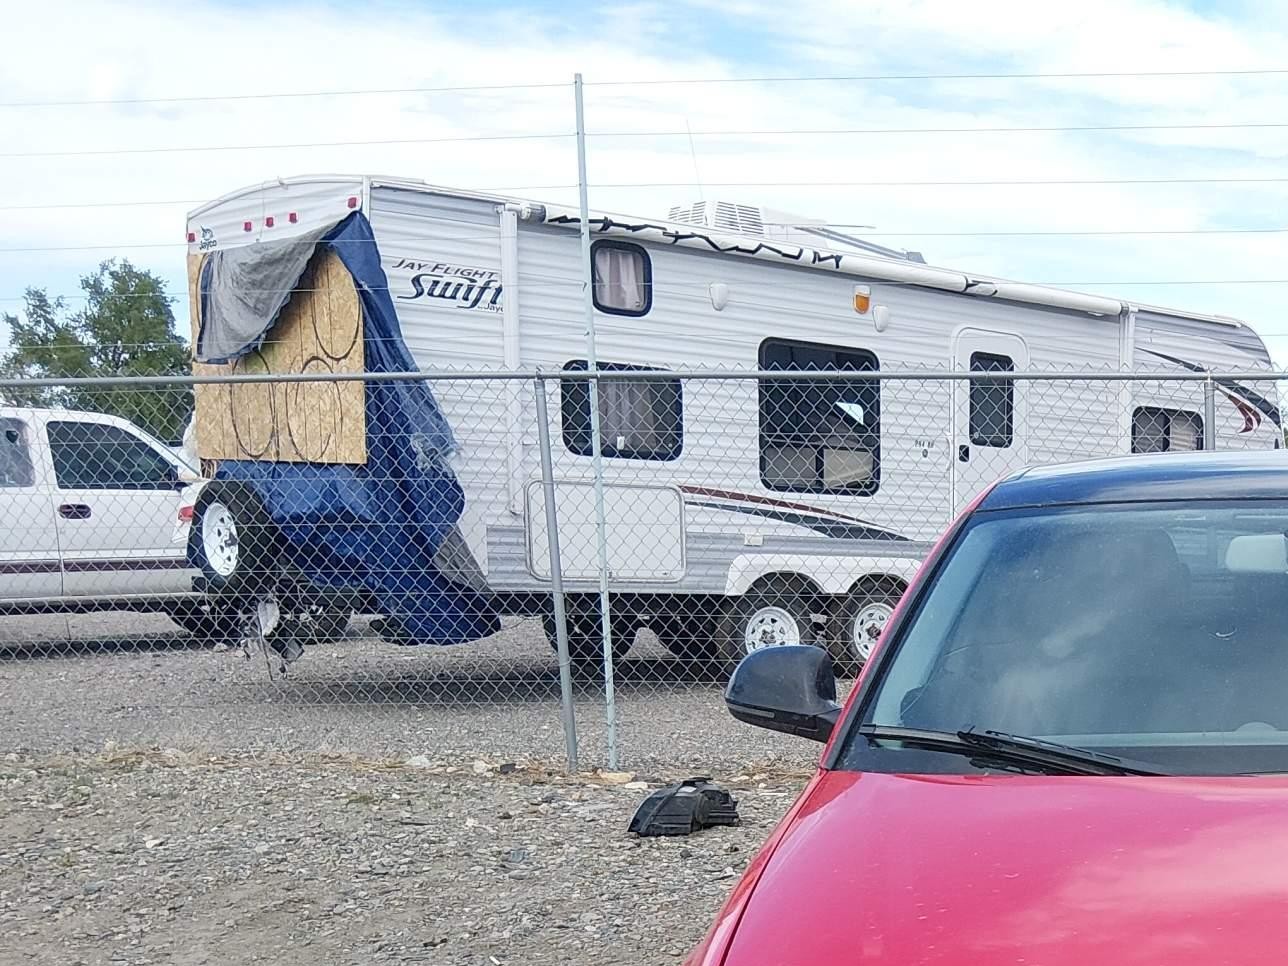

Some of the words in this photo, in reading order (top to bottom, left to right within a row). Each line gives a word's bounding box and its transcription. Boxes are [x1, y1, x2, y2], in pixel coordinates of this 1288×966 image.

[199, 240, 218, 251] Jayco
[392, 259, 429, 273] JAY
[430, 263, 499, 279] FLIGHT
[397, 273, 503, 309] Swift
